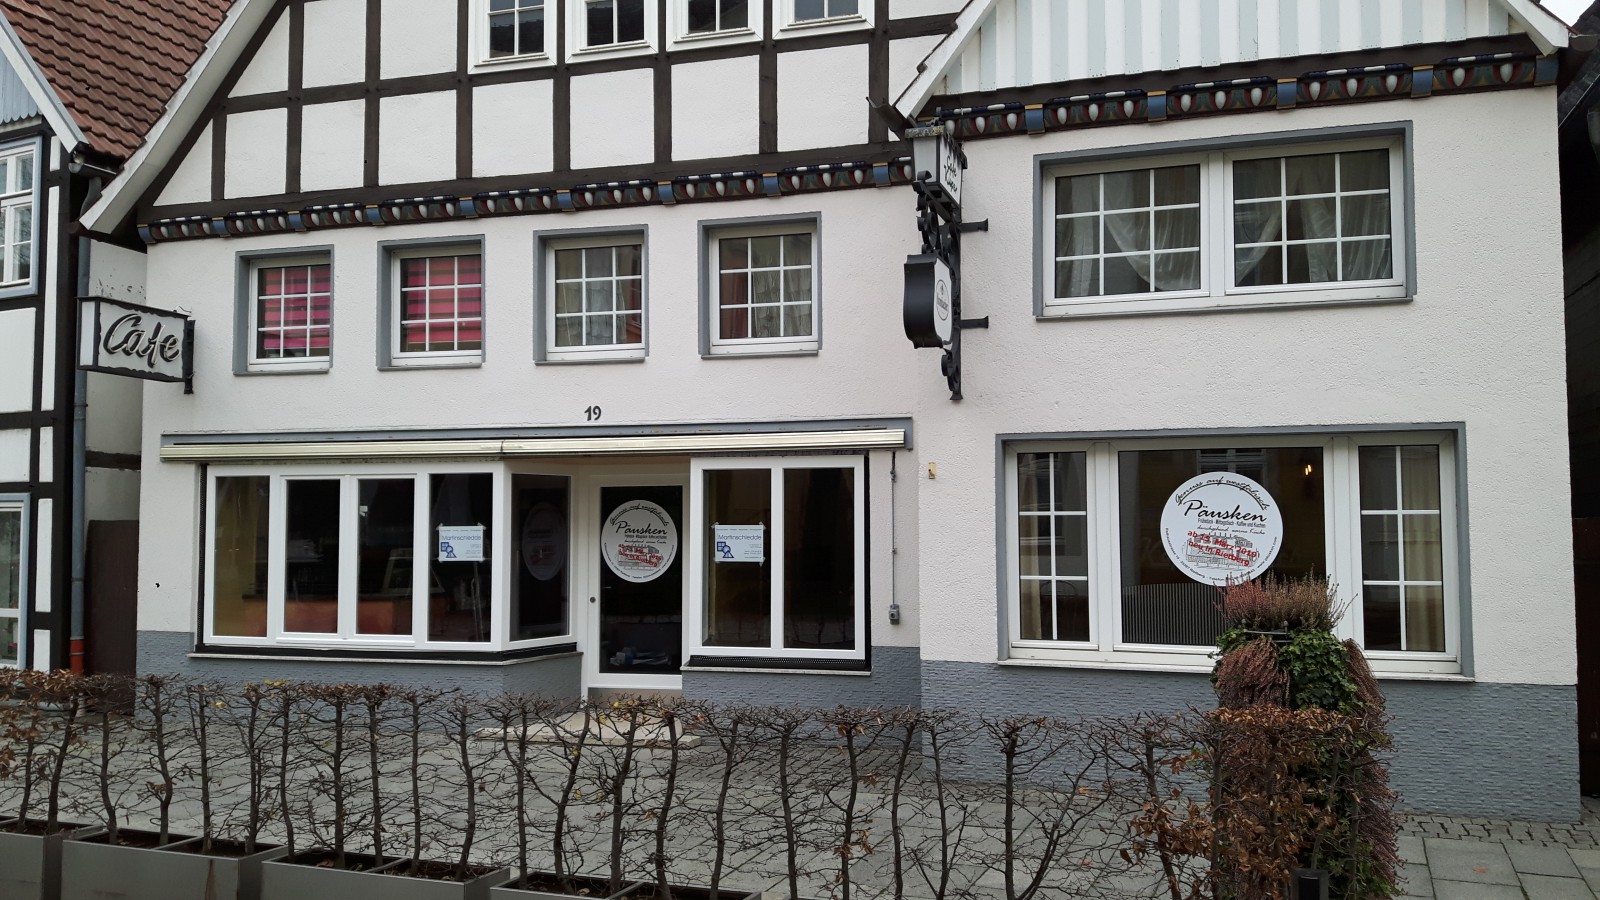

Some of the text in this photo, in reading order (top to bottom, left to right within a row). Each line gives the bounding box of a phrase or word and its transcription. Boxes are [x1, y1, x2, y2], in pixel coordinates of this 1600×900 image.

[103, 313, 181, 368] Cafe
[584, 405, 601, 421] 19
[1183, 500, 1267, 522] Päusken
[615, 521, 667, 535] Päusken
[1187, 530, 1198, 538] ab
[1213, 538, 1235, 551] März
[1236, 545, 1257, 558] 2019
[1188, 541, 1204, 550] neu
[1205, 545, 1213, 553] in
[1215, 548, 1250, 567] Rietberg
